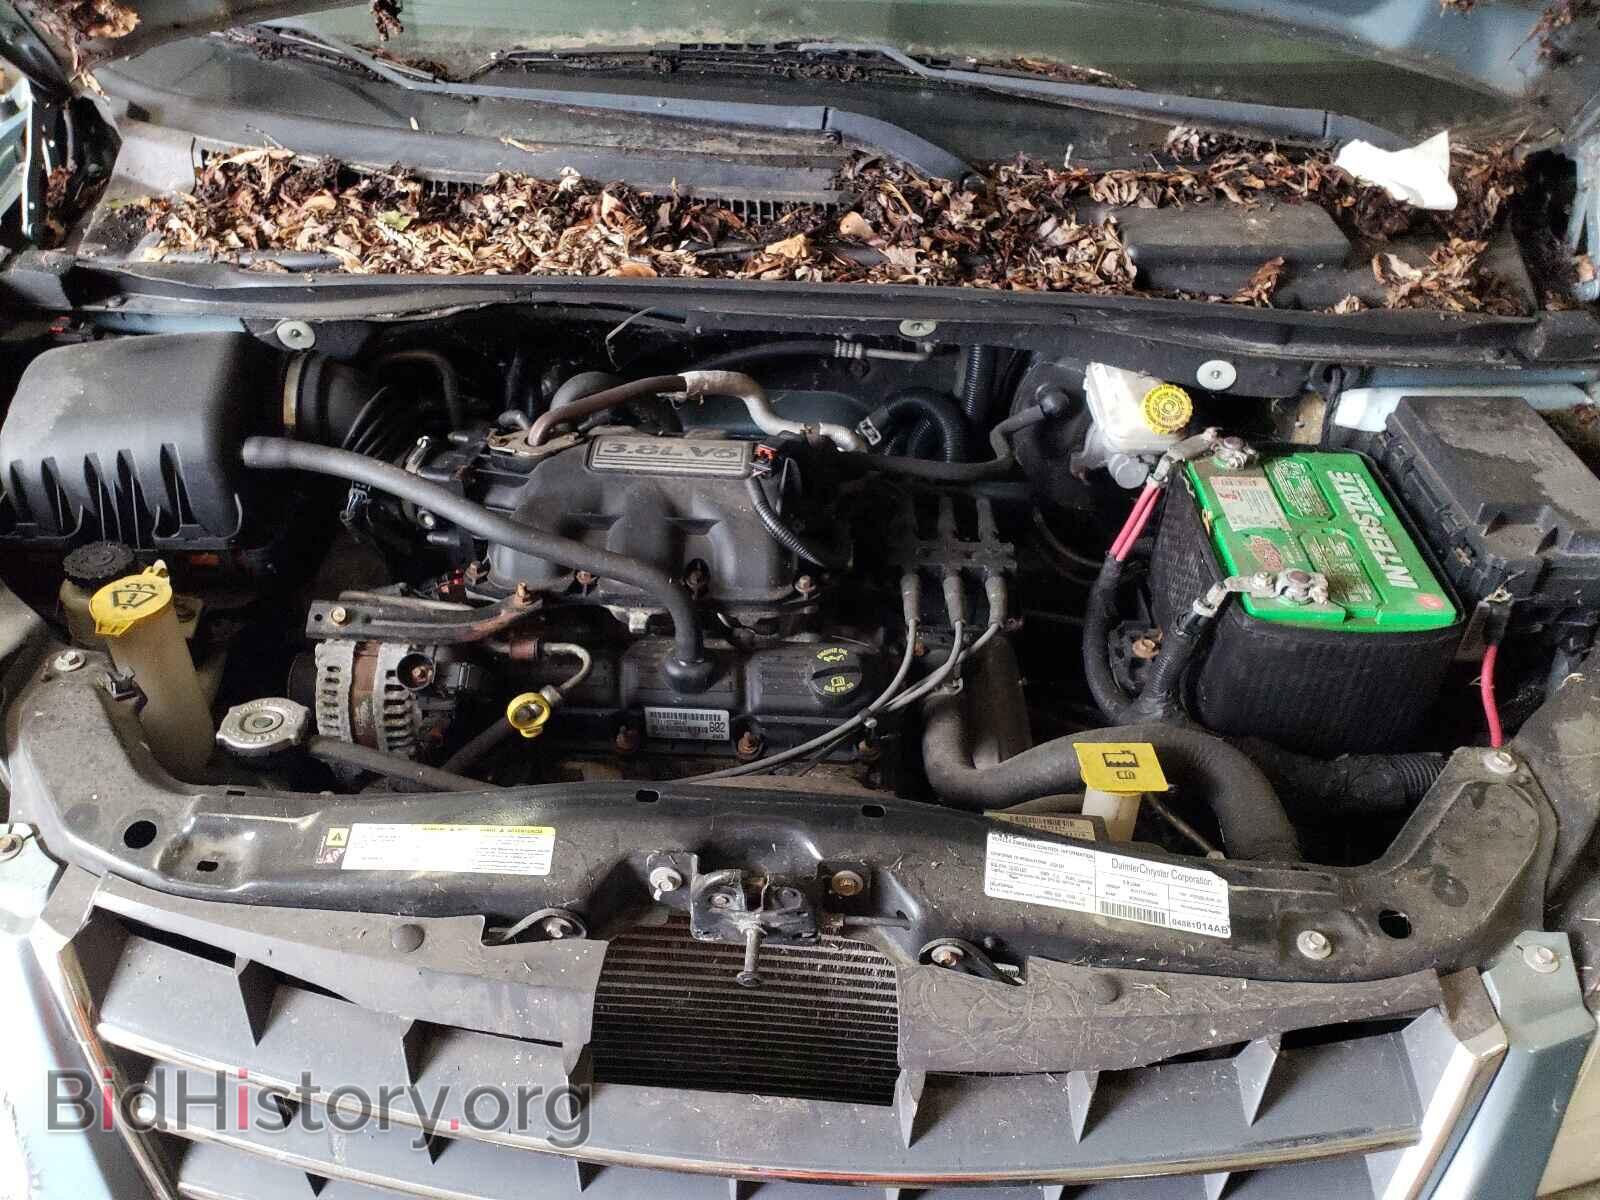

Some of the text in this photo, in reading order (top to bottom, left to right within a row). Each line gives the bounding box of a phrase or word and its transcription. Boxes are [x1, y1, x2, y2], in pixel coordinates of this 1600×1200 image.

[1327, 470, 1419, 589] INTERSTATE
[1111, 858, 1169, 879] DaimlerChrysler
[1170, 869, 1213, 887] Corporation
